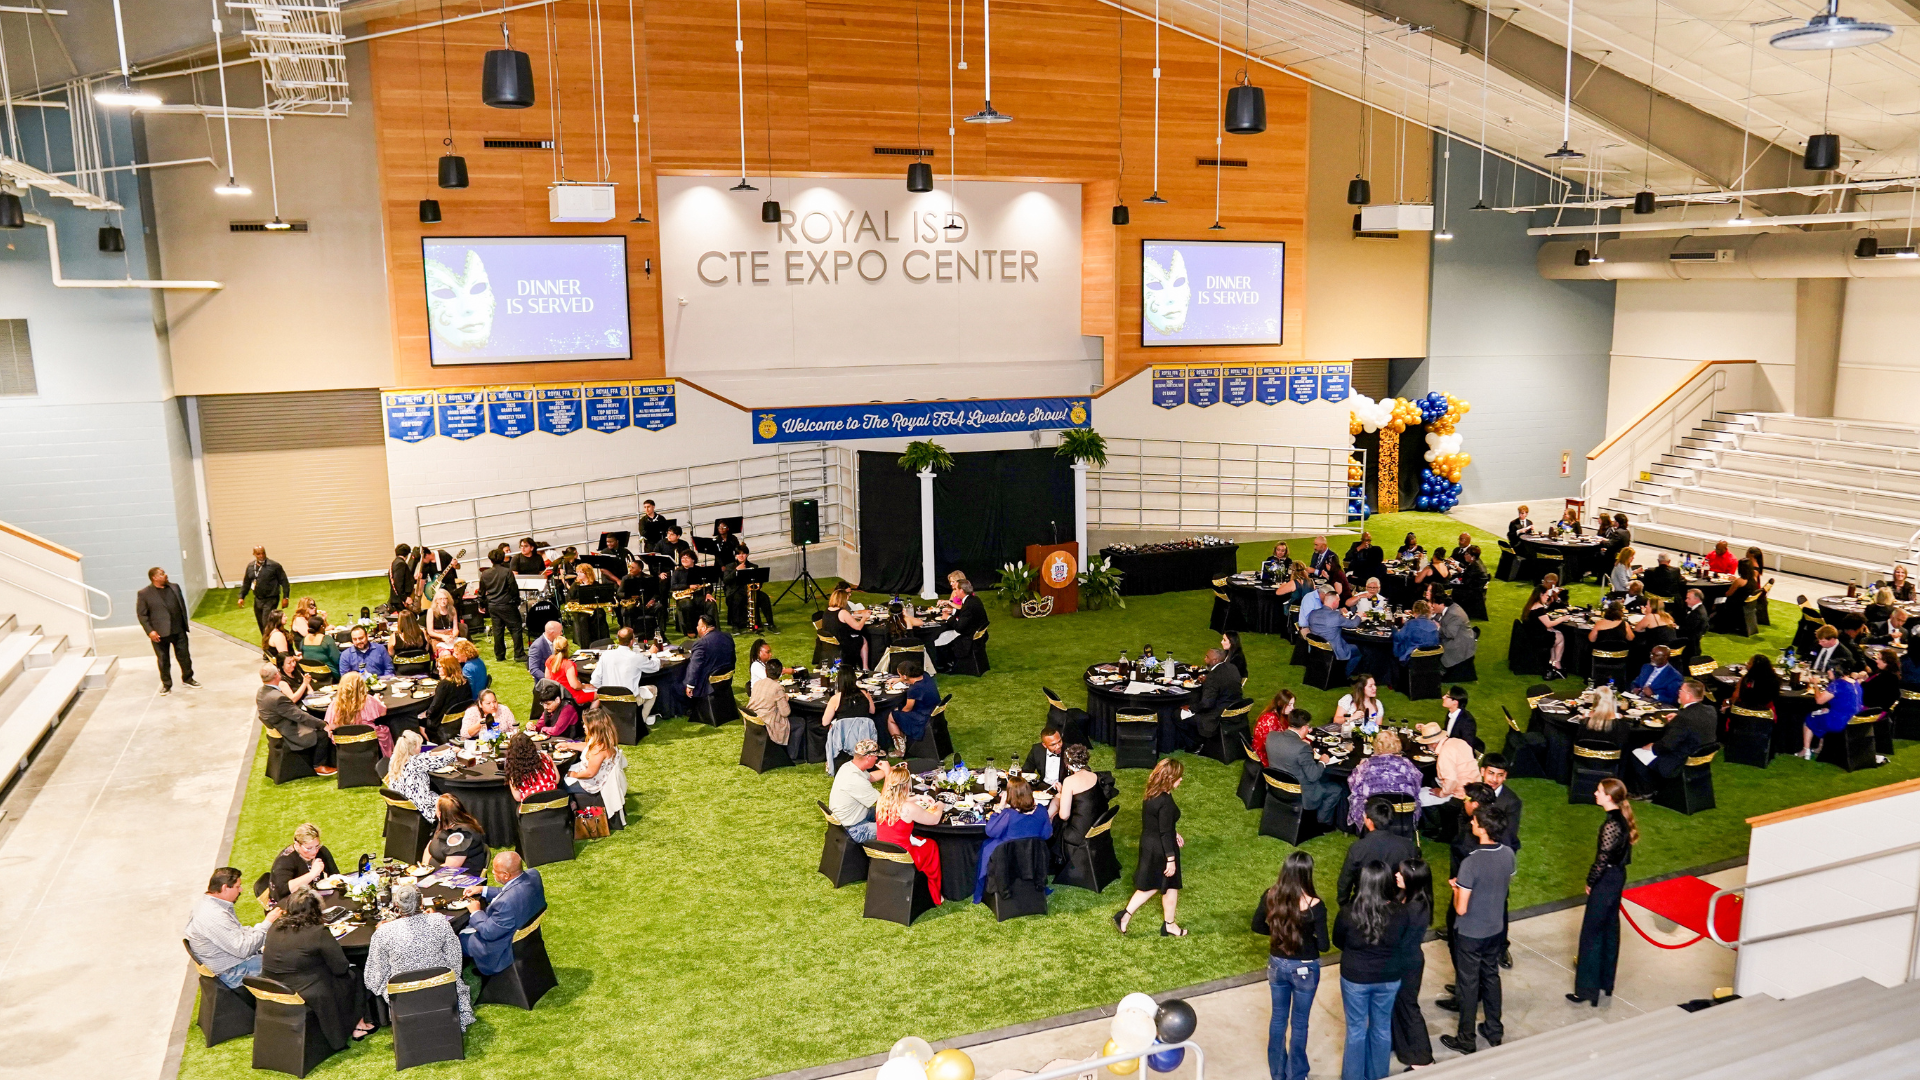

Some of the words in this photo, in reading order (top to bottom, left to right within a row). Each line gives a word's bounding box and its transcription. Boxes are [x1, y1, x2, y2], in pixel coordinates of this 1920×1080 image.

[778, 209, 899, 244] ROYAL
[913, 209, 969, 243] ISD
[697, 249, 770, 284] CTE
[785, 249, 887, 284] EXPO
[902, 249, 1039, 284] CENTER
[517, 279, 581, 296] DINNER
[1206, 275, 1252, 290] DINNER
[506, 298, 523, 314] IS
[528, 297, 594, 314] SERVED
[1198, 291, 1210, 304] IS
[1213, 291, 1260, 304] SERVED
[782, 417, 844, 433] Welcome
[845, 416, 860, 430] to
[863, 413, 889, 430] The
[891, 412, 930, 432] Royal
[932, 410, 966, 427] FFA
[966, 409, 1027, 428] Livestock
[1027, 407, 1069, 425] Show!
